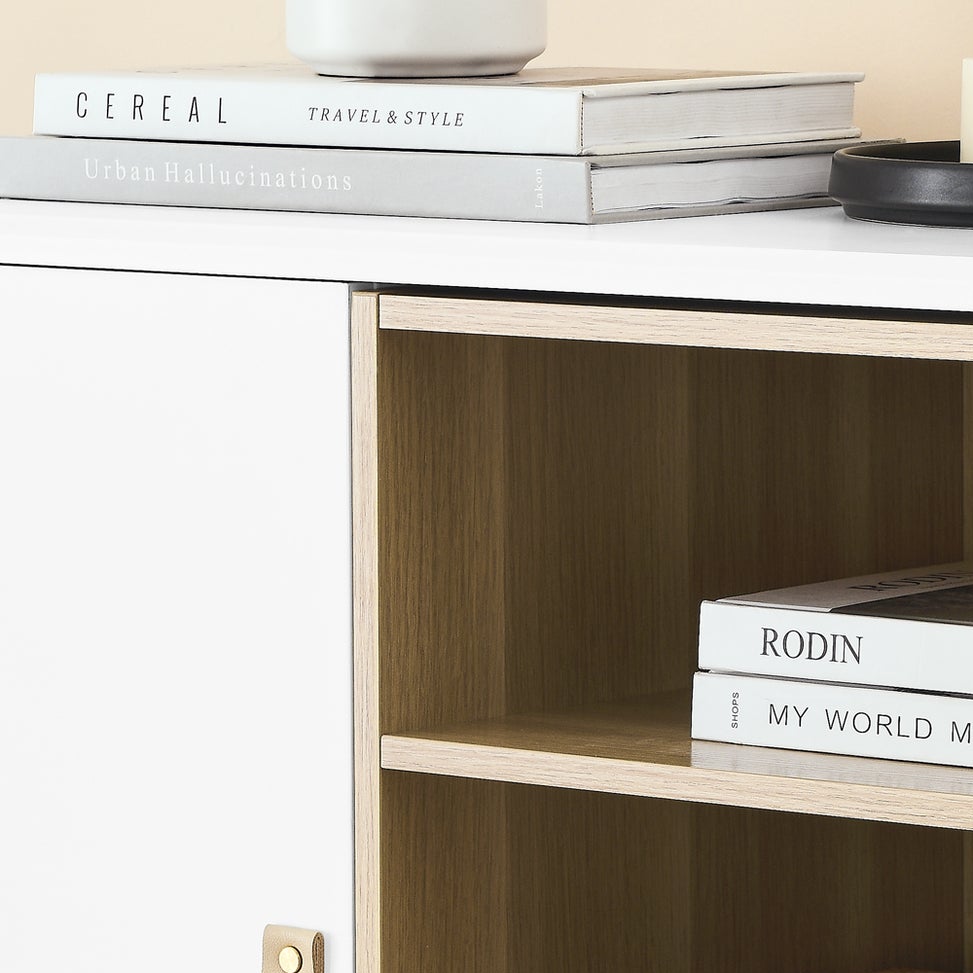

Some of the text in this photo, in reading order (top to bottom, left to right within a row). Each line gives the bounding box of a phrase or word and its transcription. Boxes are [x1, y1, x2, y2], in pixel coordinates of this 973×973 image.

[77, 92, 227, 125] CEREAL
[308, 107, 465, 127] TRAVEL & STYLE
[84, 158, 352, 191] Urban Hallucinations
[534, 168, 544, 208] Lakon
[760, 627, 863, 665] RODIN
[731, 692, 740, 729] SHOPS
[769, 704, 809, 728] MY
[825, 709, 933, 740] WORLD
